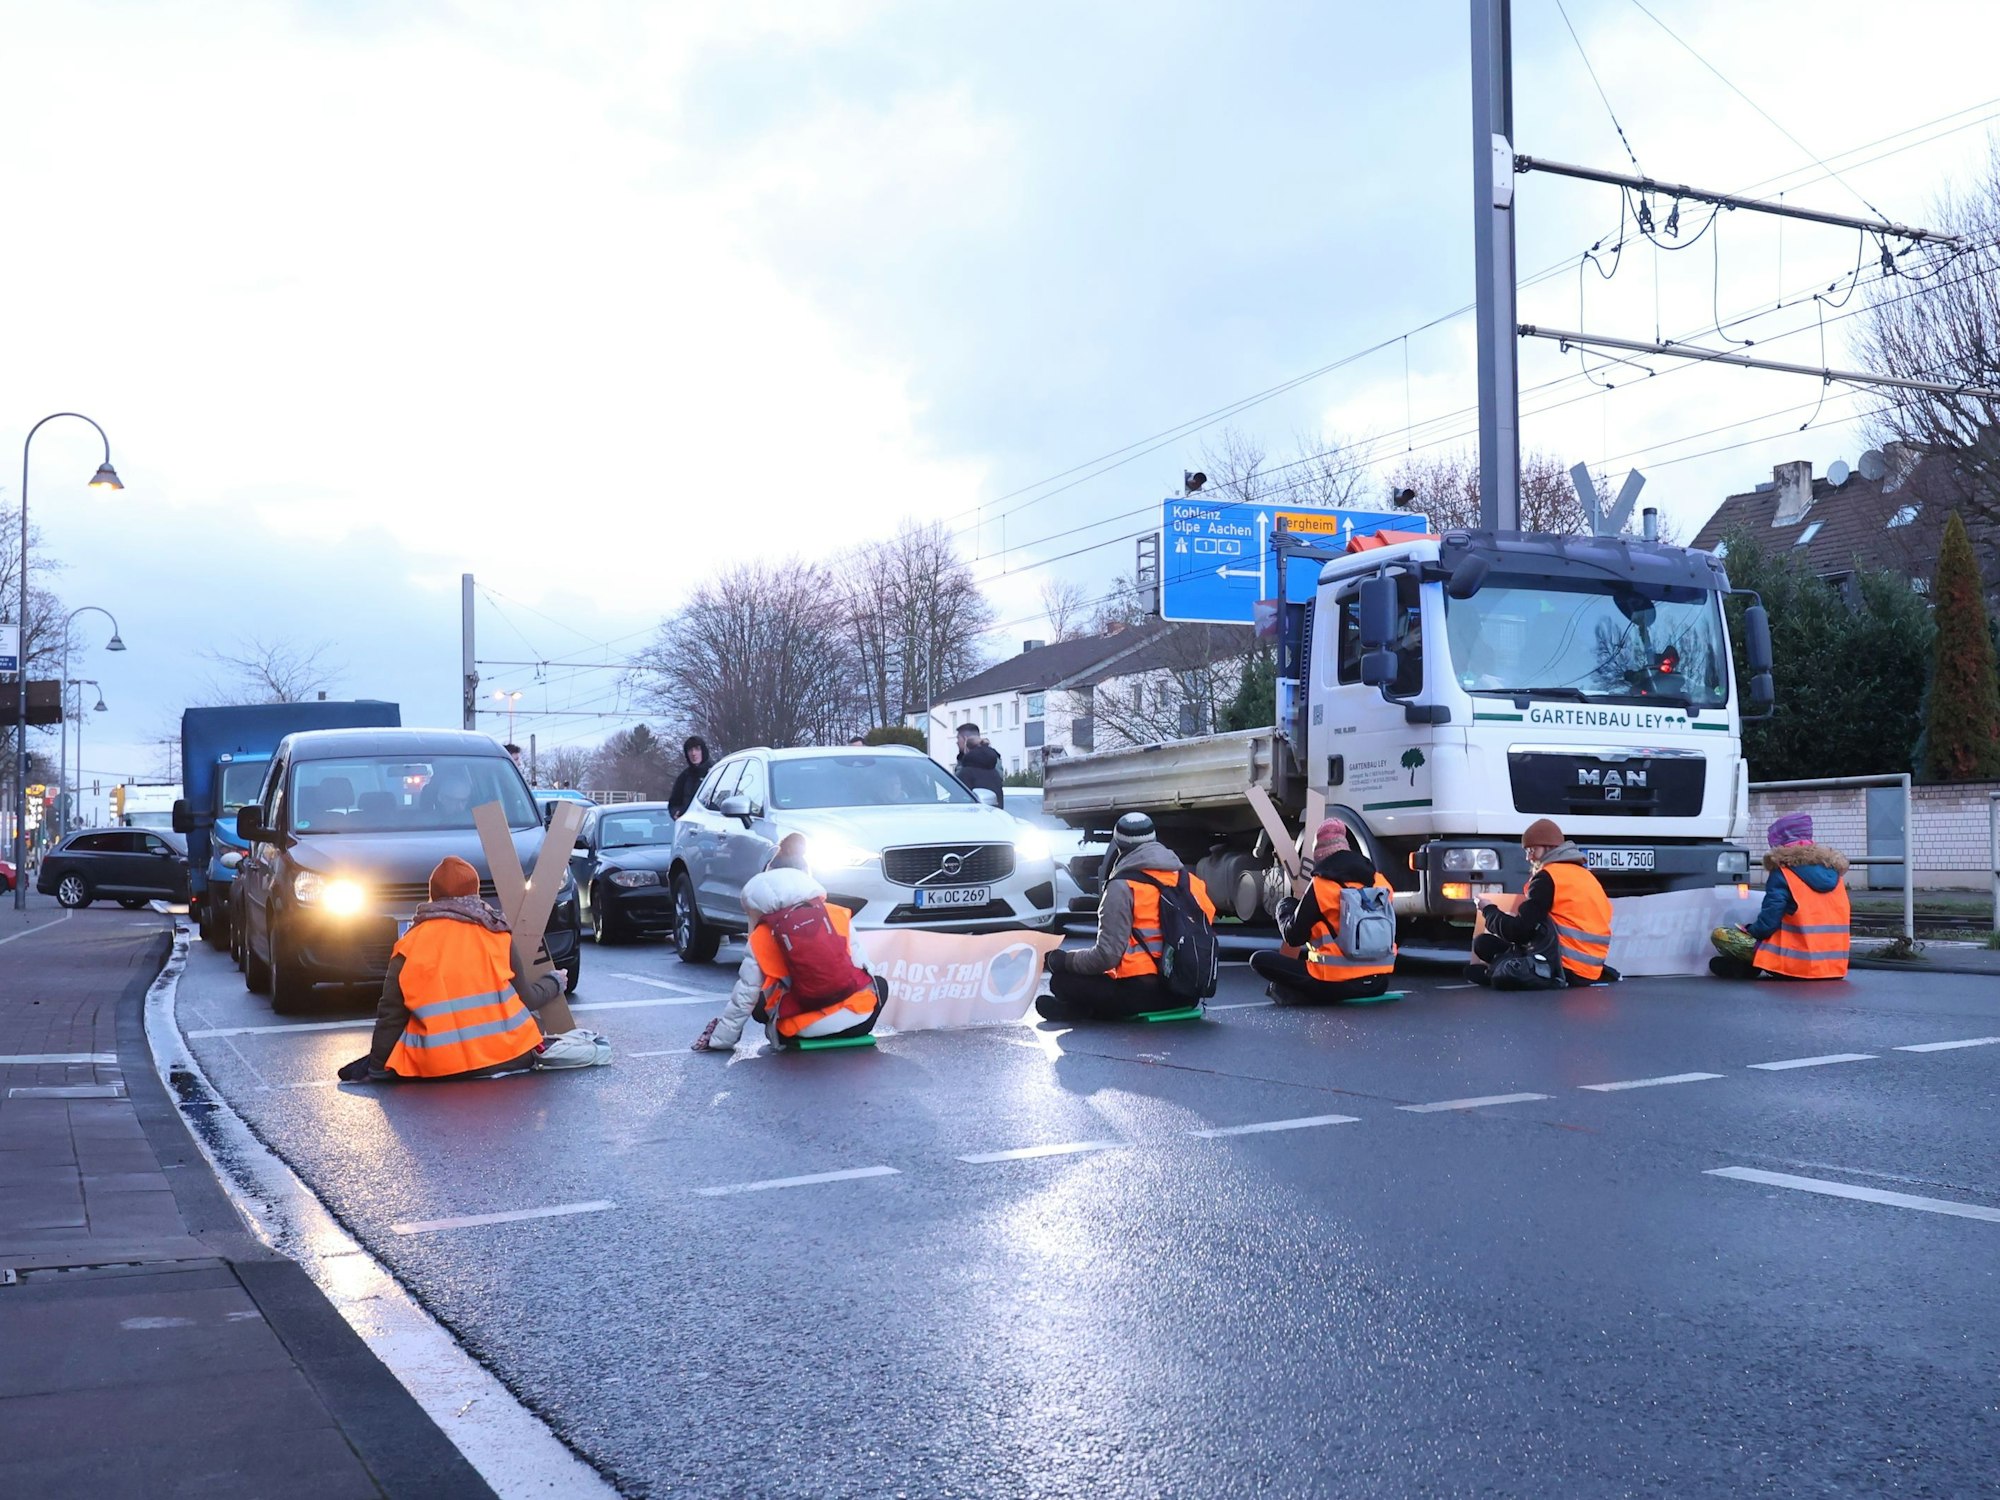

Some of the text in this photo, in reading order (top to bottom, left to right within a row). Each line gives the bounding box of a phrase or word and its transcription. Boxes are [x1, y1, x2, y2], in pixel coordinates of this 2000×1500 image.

[1173, 519, 1252, 536] Olpe Aachen
[1286, 517, 1333, 532] ergheim
[1530, 708, 1663, 729] GARTENBAU LEY
[1578, 768, 1647, 787] MAN
[1588, 852, 1653, 867] BM GL 7500
[928, 889, 985, 904] K OC 269
